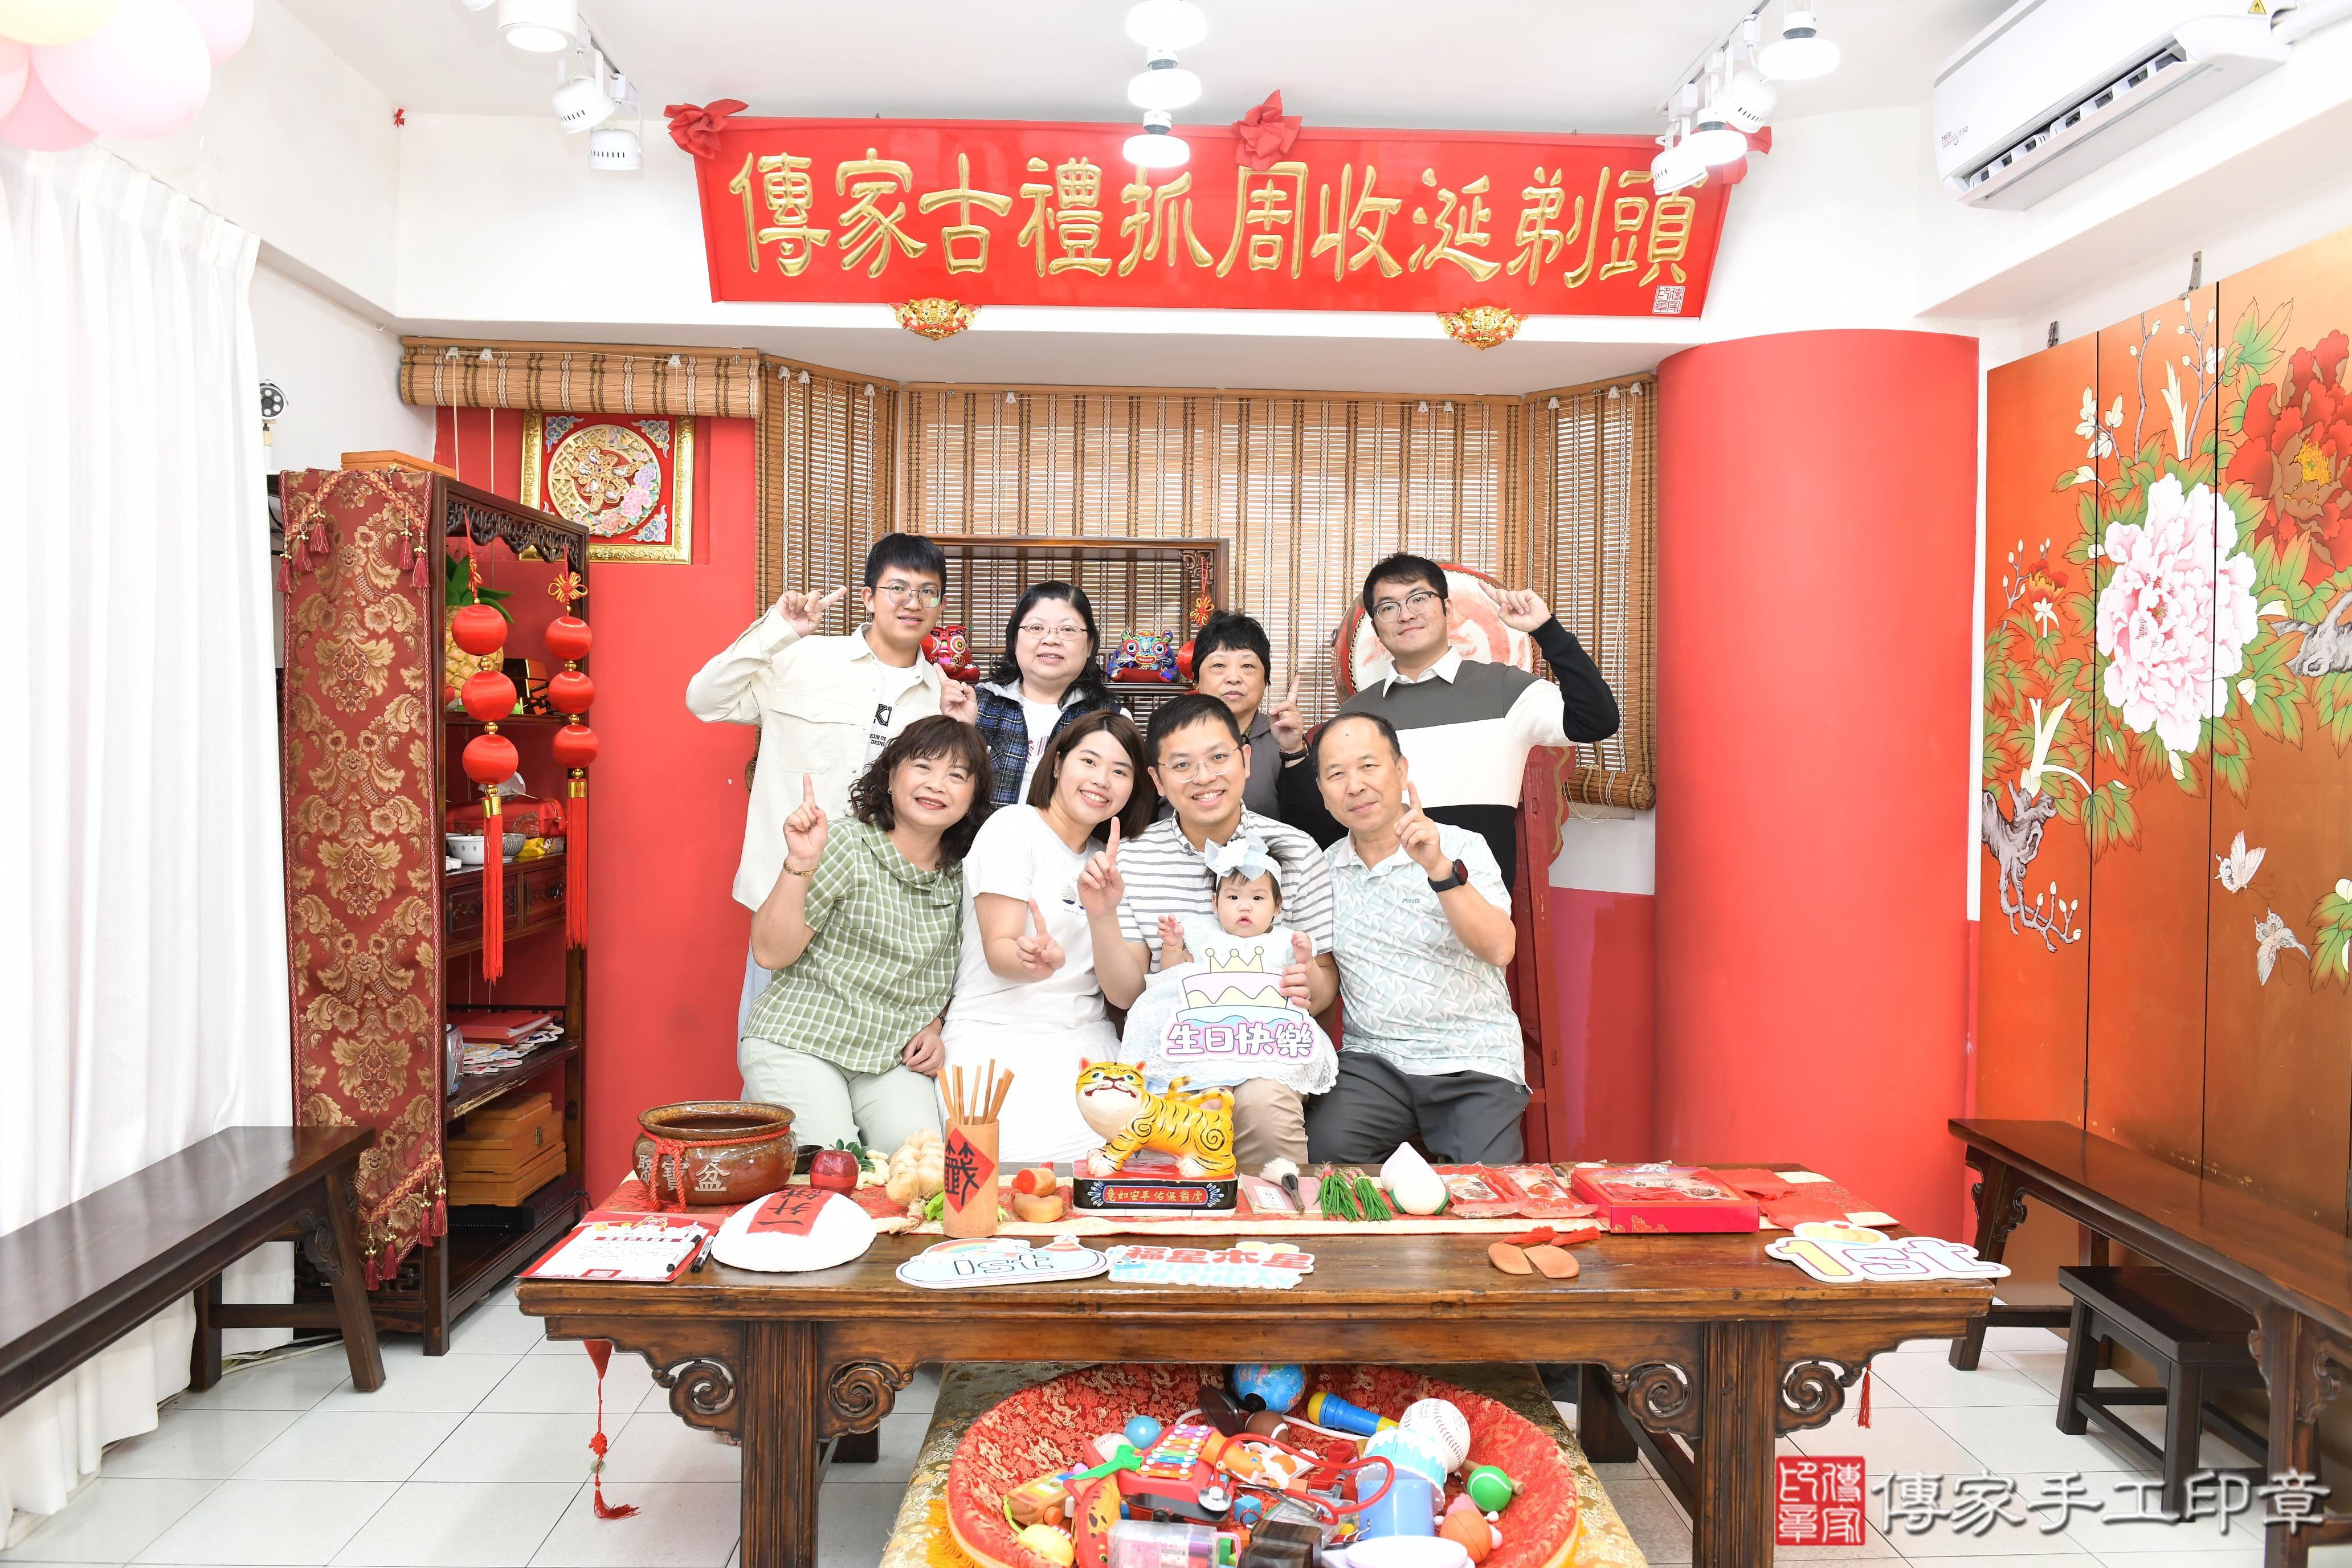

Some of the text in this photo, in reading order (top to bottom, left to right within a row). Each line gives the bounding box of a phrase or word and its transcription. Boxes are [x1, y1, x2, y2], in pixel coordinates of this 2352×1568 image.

[729, 148, 1709, 288] 傳家古禮抓周收涎剃頭
[1167, 1022, 1313, 1057] 生日快樂
[1776, 1240, 2000, 1276] 1st
